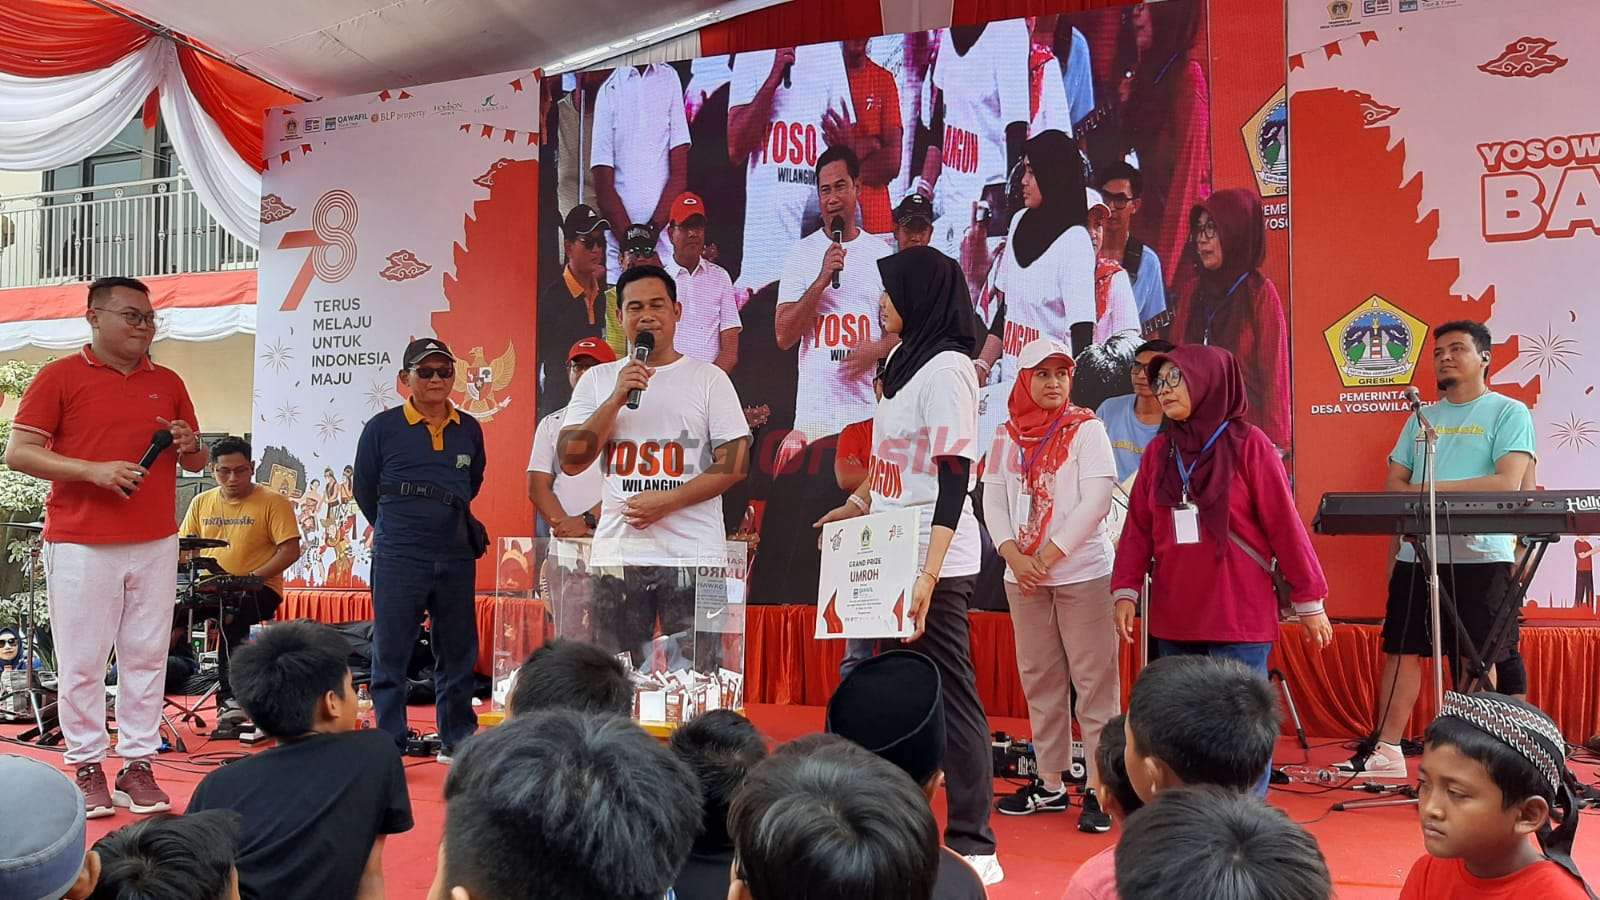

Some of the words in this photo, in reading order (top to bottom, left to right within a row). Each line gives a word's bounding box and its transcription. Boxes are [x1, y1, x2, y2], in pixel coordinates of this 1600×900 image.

[337, 113, 368, 123] QAWAFIL
[381, 112, 396, 121] BLP
[314, 298, 360, 313] TERUS
[313, 316, 372, 331] MELAJU
[312, 335, 361, 349] UNTUK
[311, 352, 391, 367] INDONESIA
[311, 372, 352, 386] MAJU
[1358, 377, 1396, 385] GRESIK
[1340, 391, 1408, 402] PEMERINTA
[1311, 405, 1341, 414] DESA
[849, 559, 866, 568] GRAND
[850, 568, 879, 582] UMROH
